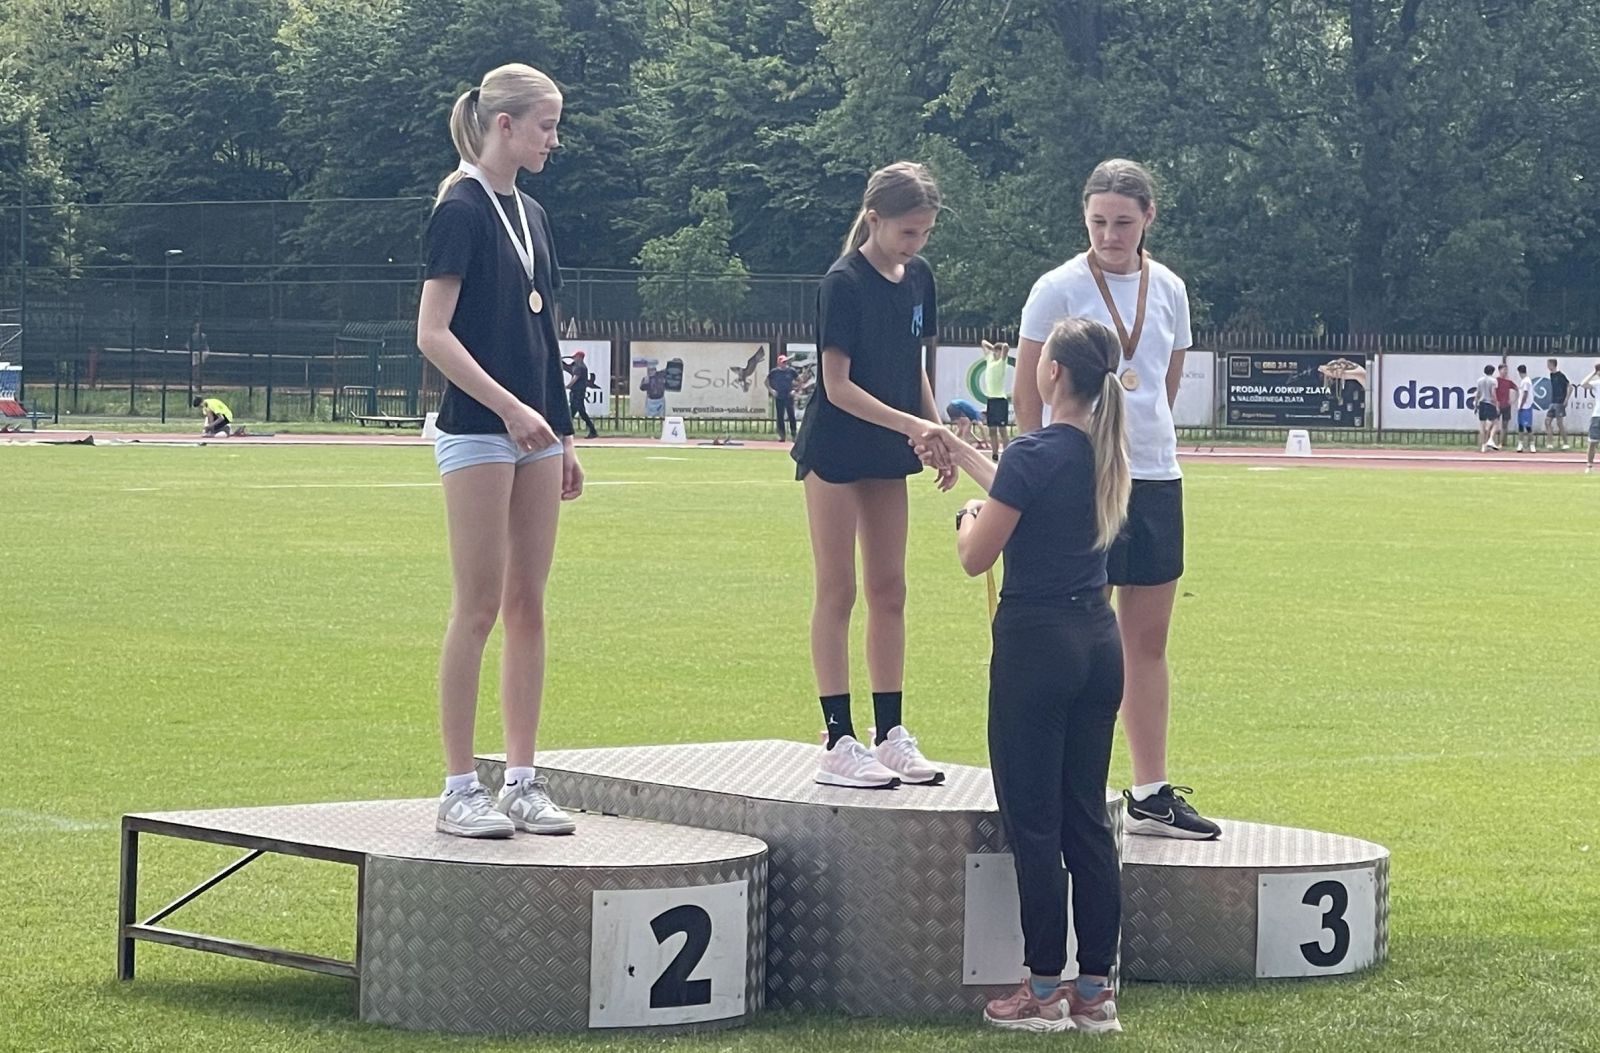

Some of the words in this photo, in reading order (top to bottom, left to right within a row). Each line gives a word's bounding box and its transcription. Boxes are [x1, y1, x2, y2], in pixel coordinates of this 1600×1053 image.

[1230, 385, 1267, 394] PRODAJA
[1274, 386, 1304, 394] ODKUP
[1305, 386, 1331, 394] ZLATA
[671, 405, 766, 414] www.gostilna-sokol.com
[671, 426, 678, 437] 4
[1296, 439, 1303, 452] 1
[1300, 880, 1351, 967] 3
[650, 904, 712, 1008] 2
